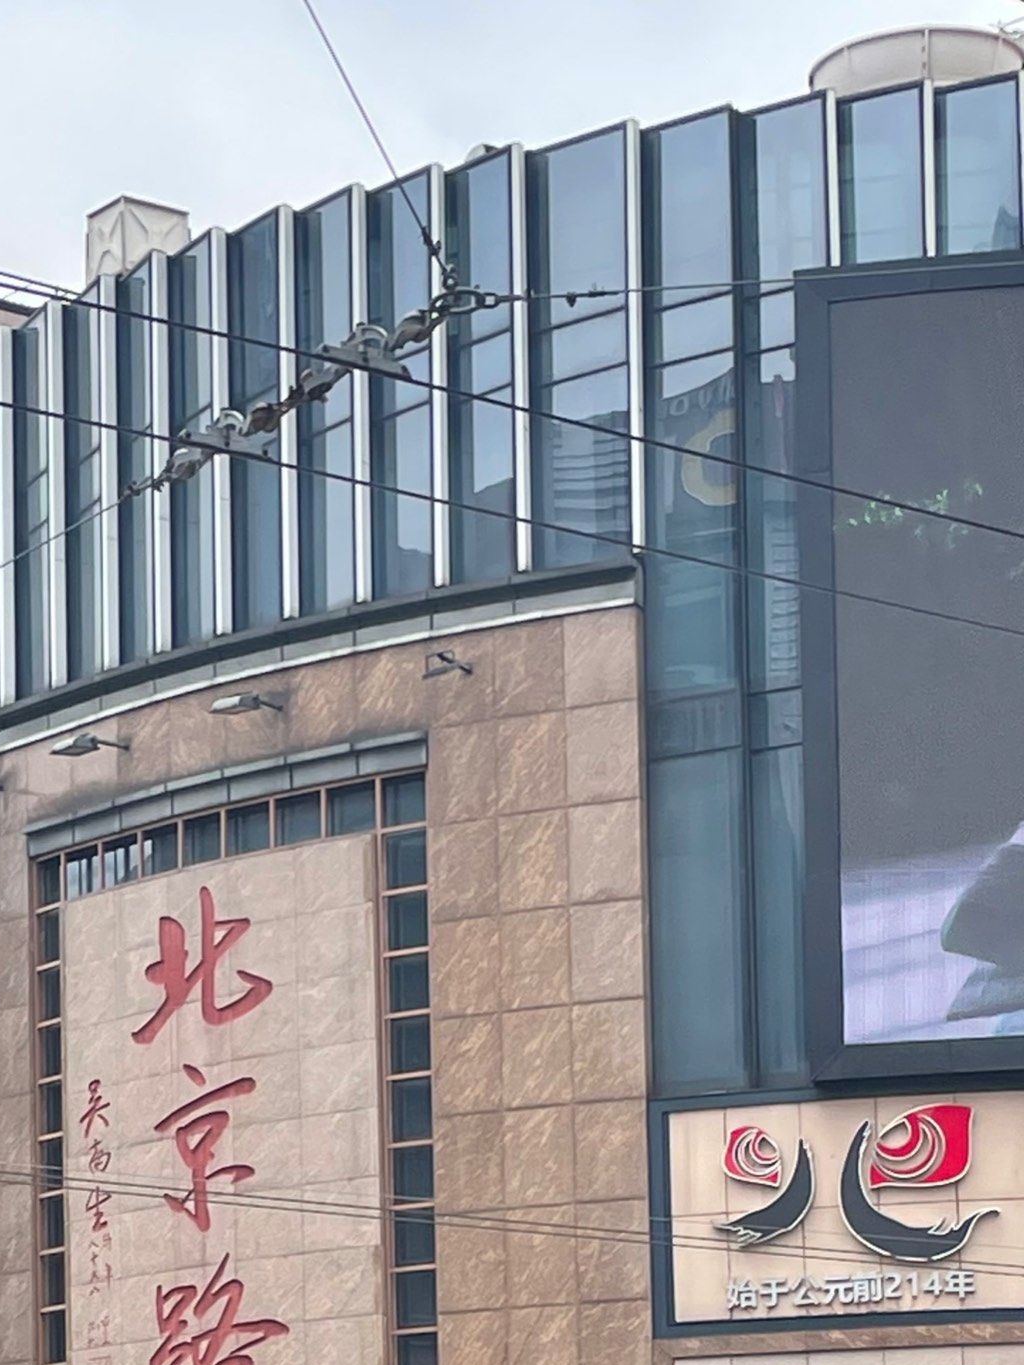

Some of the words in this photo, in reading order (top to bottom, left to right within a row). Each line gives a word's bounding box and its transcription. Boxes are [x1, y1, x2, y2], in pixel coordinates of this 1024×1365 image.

[727, 1270, 977, 1310] 始于公元前214年
